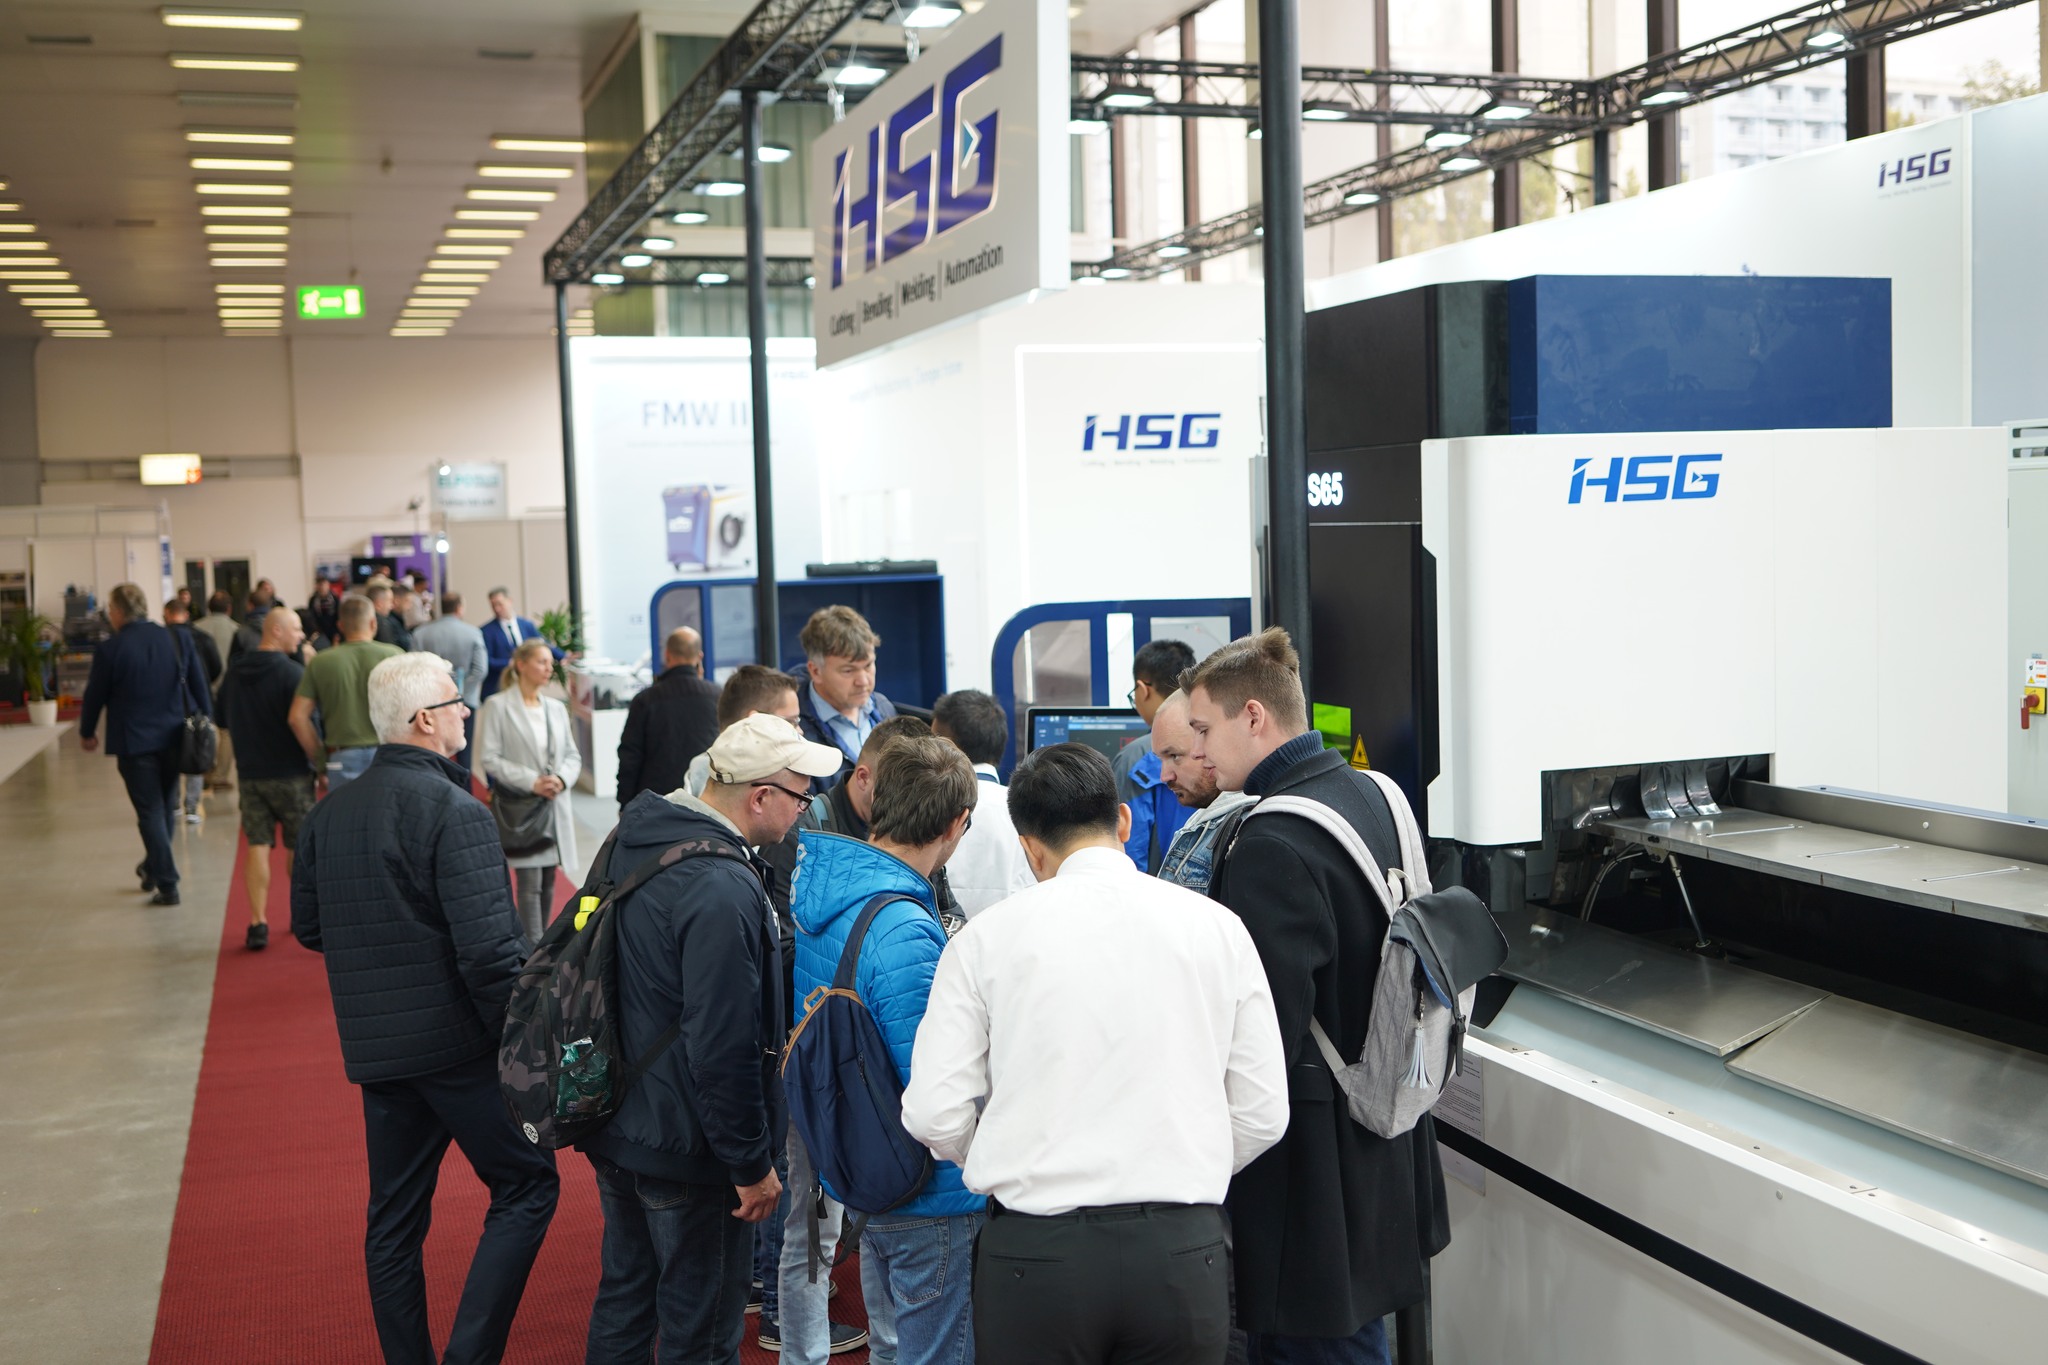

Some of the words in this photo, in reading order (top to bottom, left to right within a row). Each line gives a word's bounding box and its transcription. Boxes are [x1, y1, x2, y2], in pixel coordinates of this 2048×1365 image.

[832, 32, 1004, 290] HSG
[1878, 147, 1952, 187] HSG
[830, 311, 855, 337] Cutting
[862, 292, 893, 322] Bending
[902, 273, 936, 305] Welding
[944, 243, 1004, 288] Automation
[643, 401, 719, 427] FMW
[1083, 413, 1221, 451] HSG
[1307, 471, 1344, 507] S65
[1568, 453, 1723, 504] HSG
